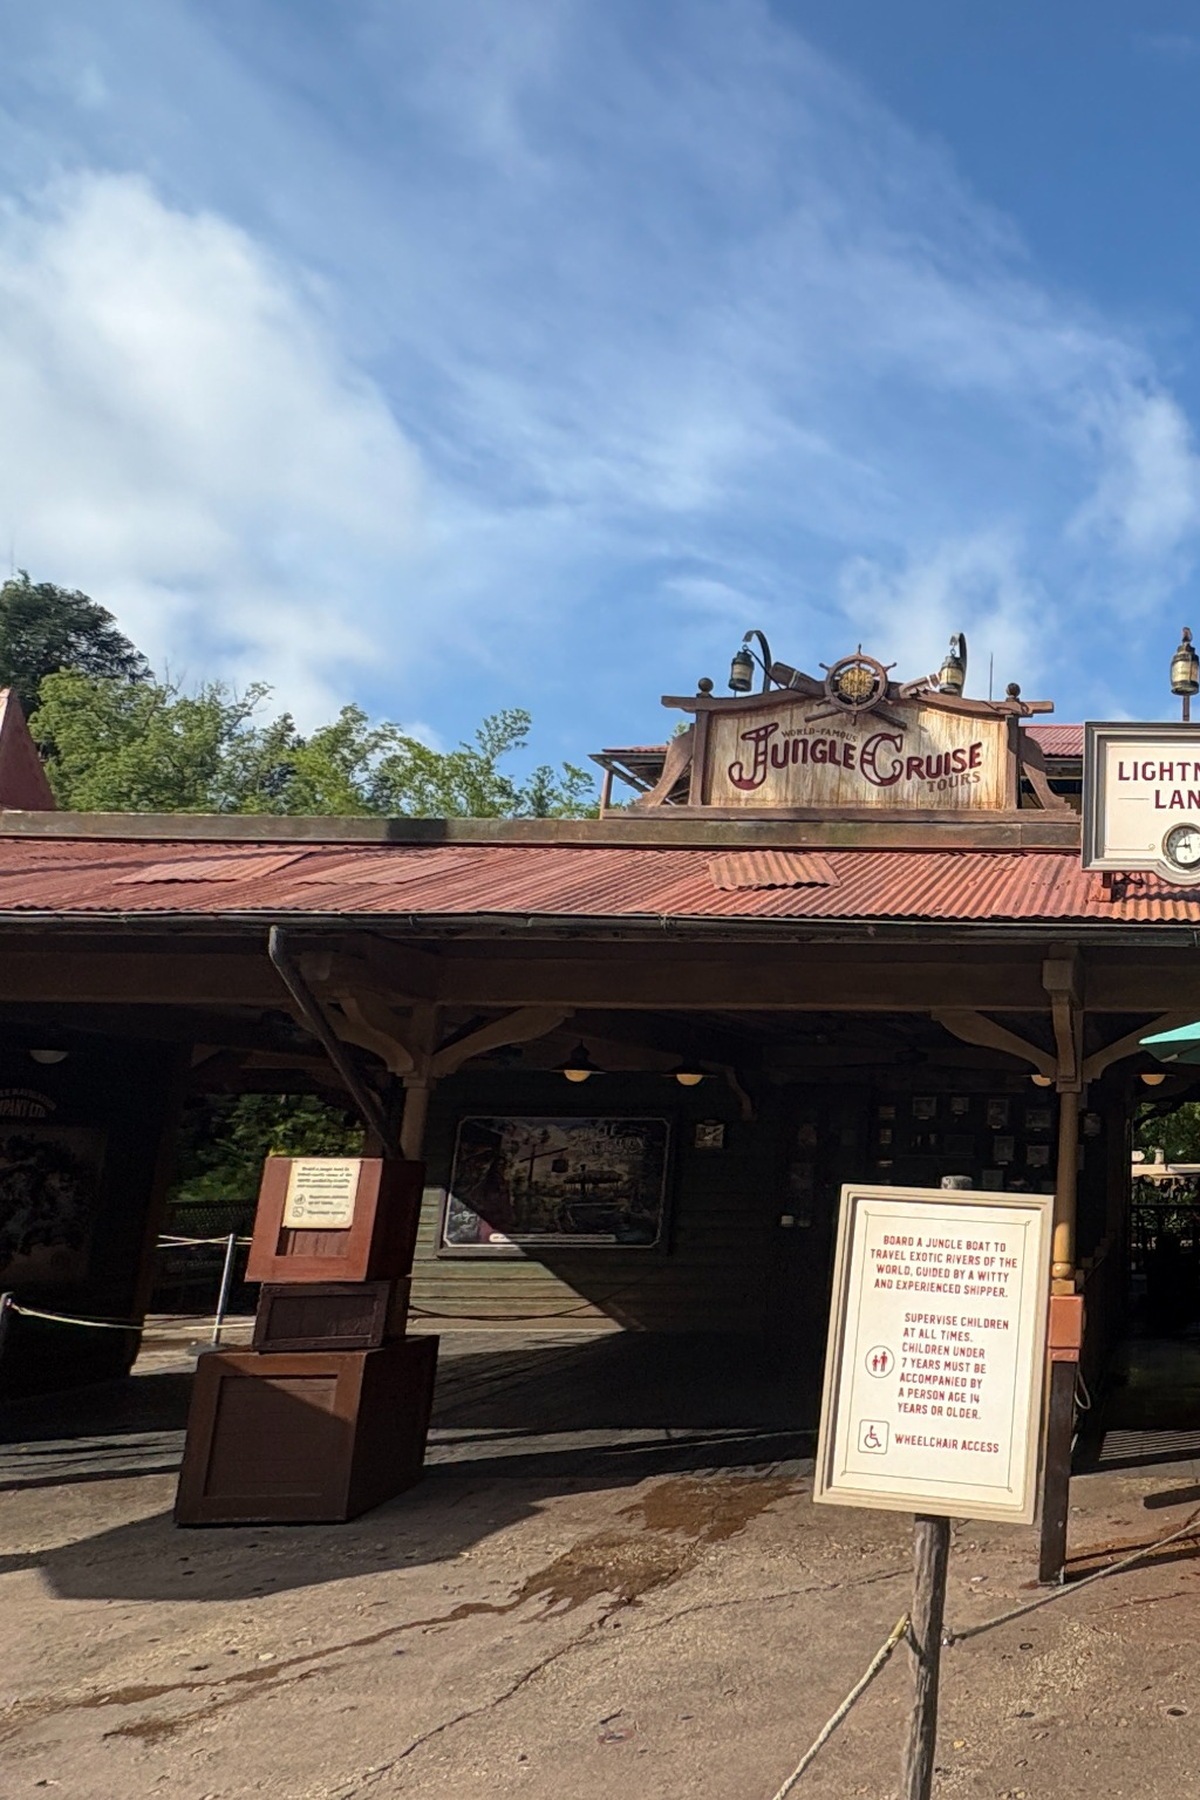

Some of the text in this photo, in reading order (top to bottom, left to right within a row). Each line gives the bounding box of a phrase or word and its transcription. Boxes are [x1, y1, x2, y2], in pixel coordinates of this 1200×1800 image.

[781, 727, 858, 742] WORLD-FAMOUS
[860, 733, 982, 786] CRUISE
[927, 771, 981, 793] TOURS
[884, 1235, 1006, 1252] BOARD A JUNGLE BOAT TO
[871, 1249, 1017, 1268] TRAVEL EXOTIC RIVERS OF THE
[877, 1264, 1009, 1283] WORLD, GUIDED BY A WITTY
[874, 1279, 892, 1289] AND
[896, 1280, 961, 1294] EXPERIENCED
[905, 1313, 1009, 1329] SUPERVISE CHILDREN
[903, 1328, 973, 1342] AT ALL TIMES.
[902, 1343, 985, 1358] CHILDREN UNDER
[902, 1358, 986, 1374] 7 YEARS MUST BE
[900, 1373, 982, 1389] ACCOMPANIED BY
[898, 1388, 980, 1404] A PERSON AGE 14
[898, 1402, 981, 1420] YEARS OR OLDER.
[895, 1434, 999, 1453] WHEELCHAIR ACCESS
